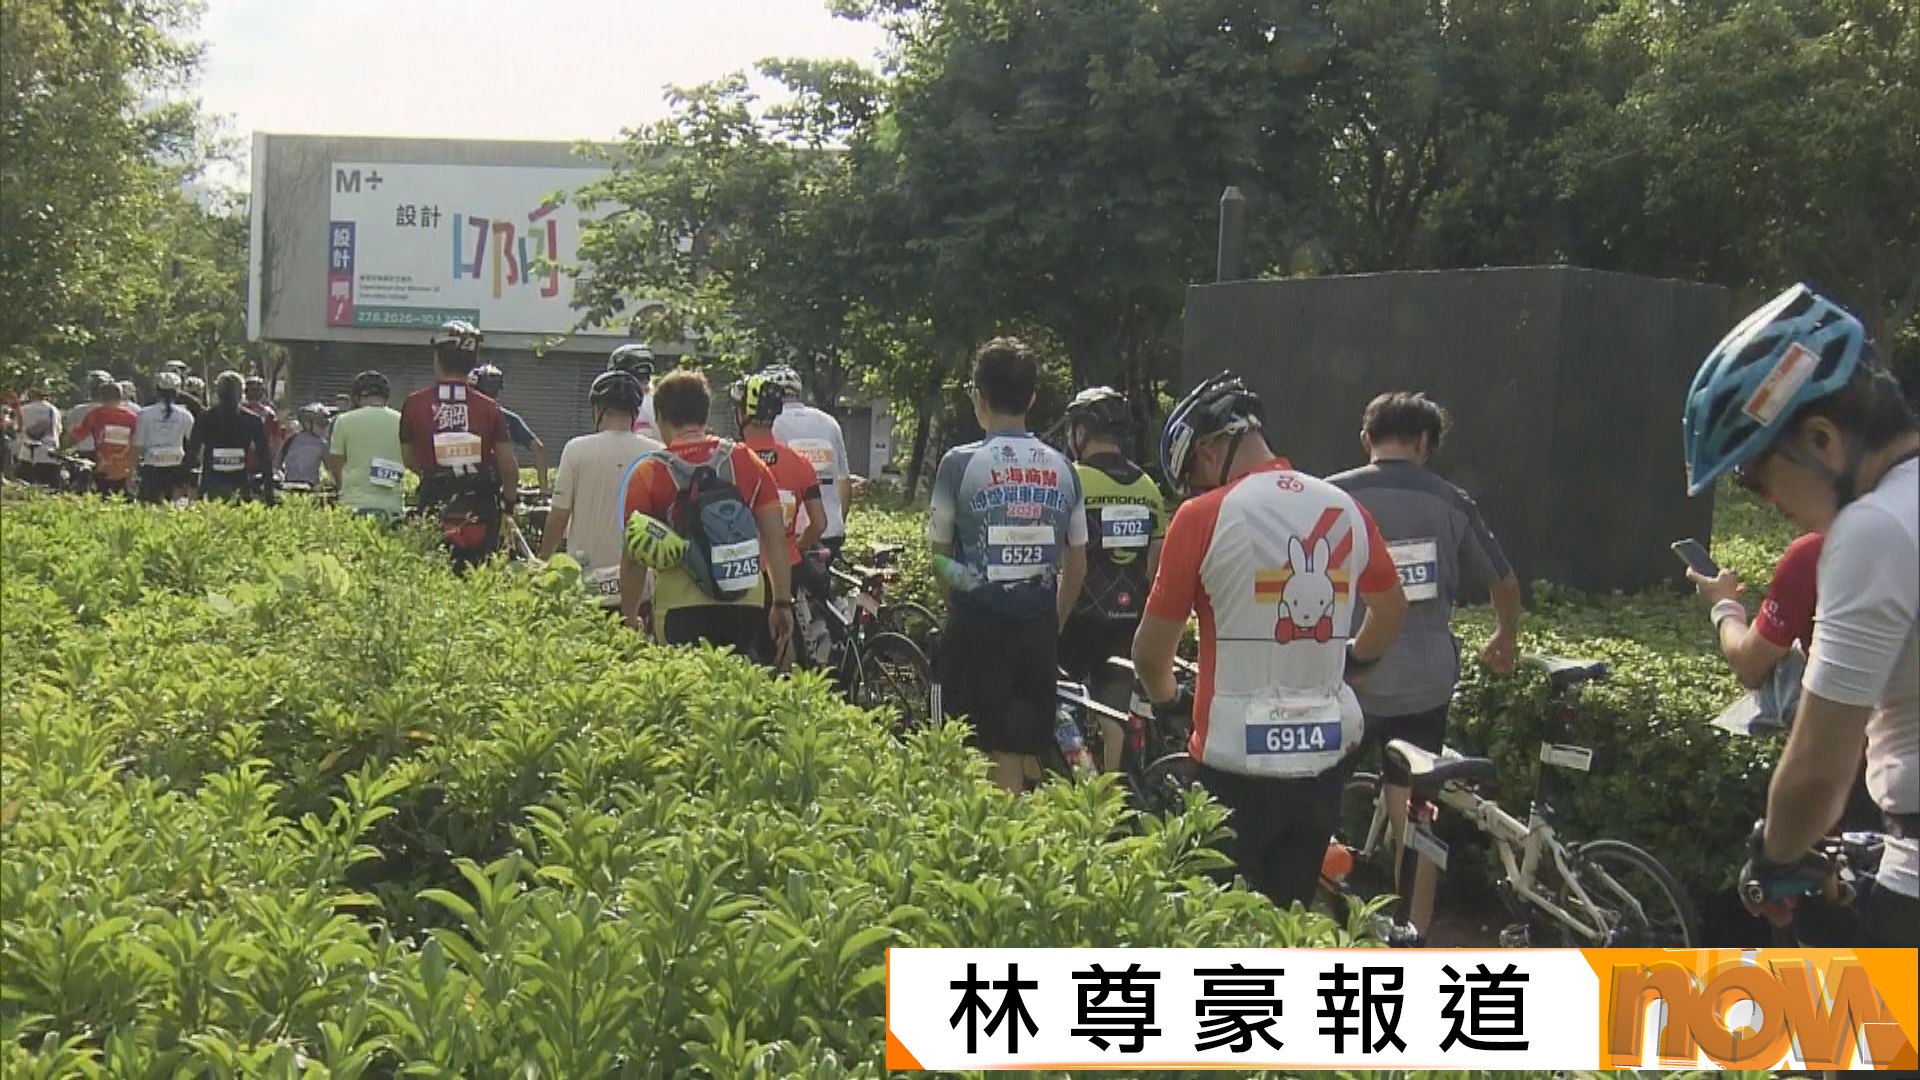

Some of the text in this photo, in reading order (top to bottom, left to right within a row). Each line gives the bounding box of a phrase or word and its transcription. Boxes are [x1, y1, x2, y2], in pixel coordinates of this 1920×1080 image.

[396, 203, 442, 229] 設計
[1113, 520, 1144, 535] 6702
[1002, 546, 1042, 563] 6523
[723, 557, 759, 578] 7245
[1266, 726, 1325, 751] 6914
